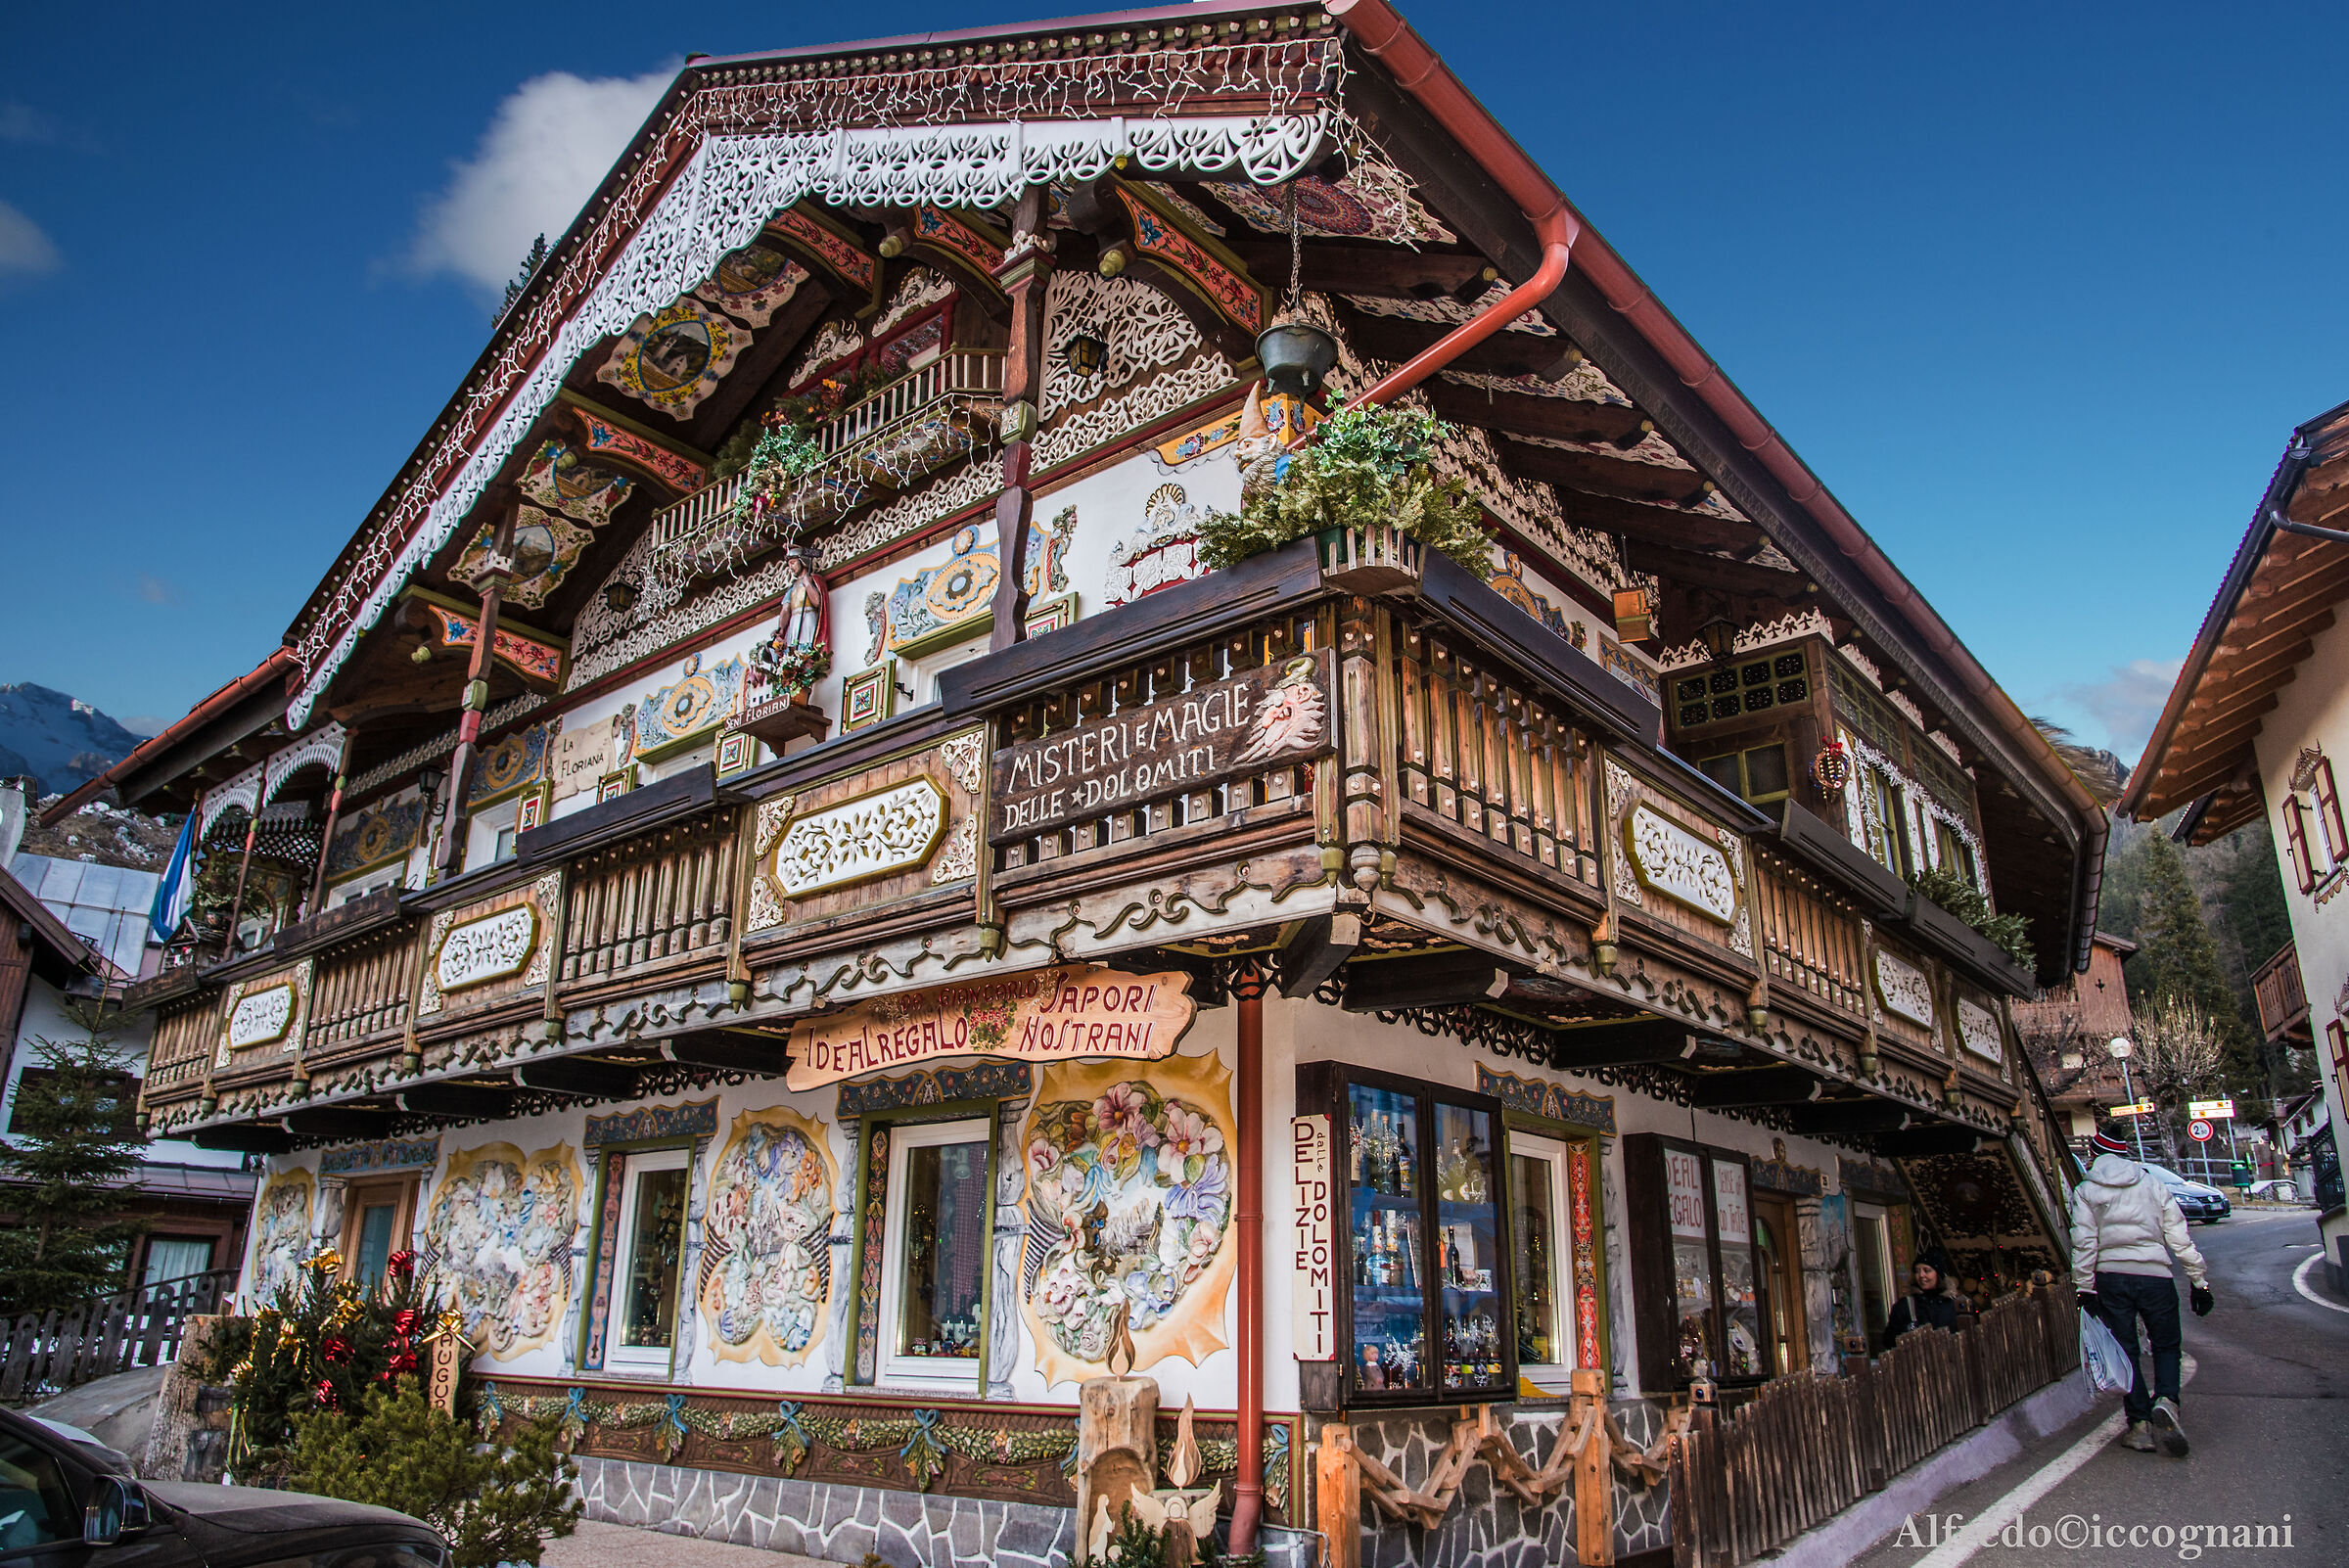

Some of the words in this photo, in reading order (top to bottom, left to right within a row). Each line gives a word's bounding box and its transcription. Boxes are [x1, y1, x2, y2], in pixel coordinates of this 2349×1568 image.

[746, 698, 787, 722] FLORIAN
[1008, 723, 1128, 794] MISTERI
[1149, 682, 1252, 753] MAGIE
[561, 752, 604, 778] FLORIANA
[1002, 787, 1066, 834] DELLE
[1083, 745, 1217, 809] DOLOMITI
[1039, 971, 1157, 1014] SAPORI
[1019, 1015, 1156, 1053] NOSTRANI
[1316, 1130, 1325, 1174] dalle
[1294, 1122, 1315, 1271] DELIZIE
[1310, 1180, 1330, 1355] DOLOMITI
